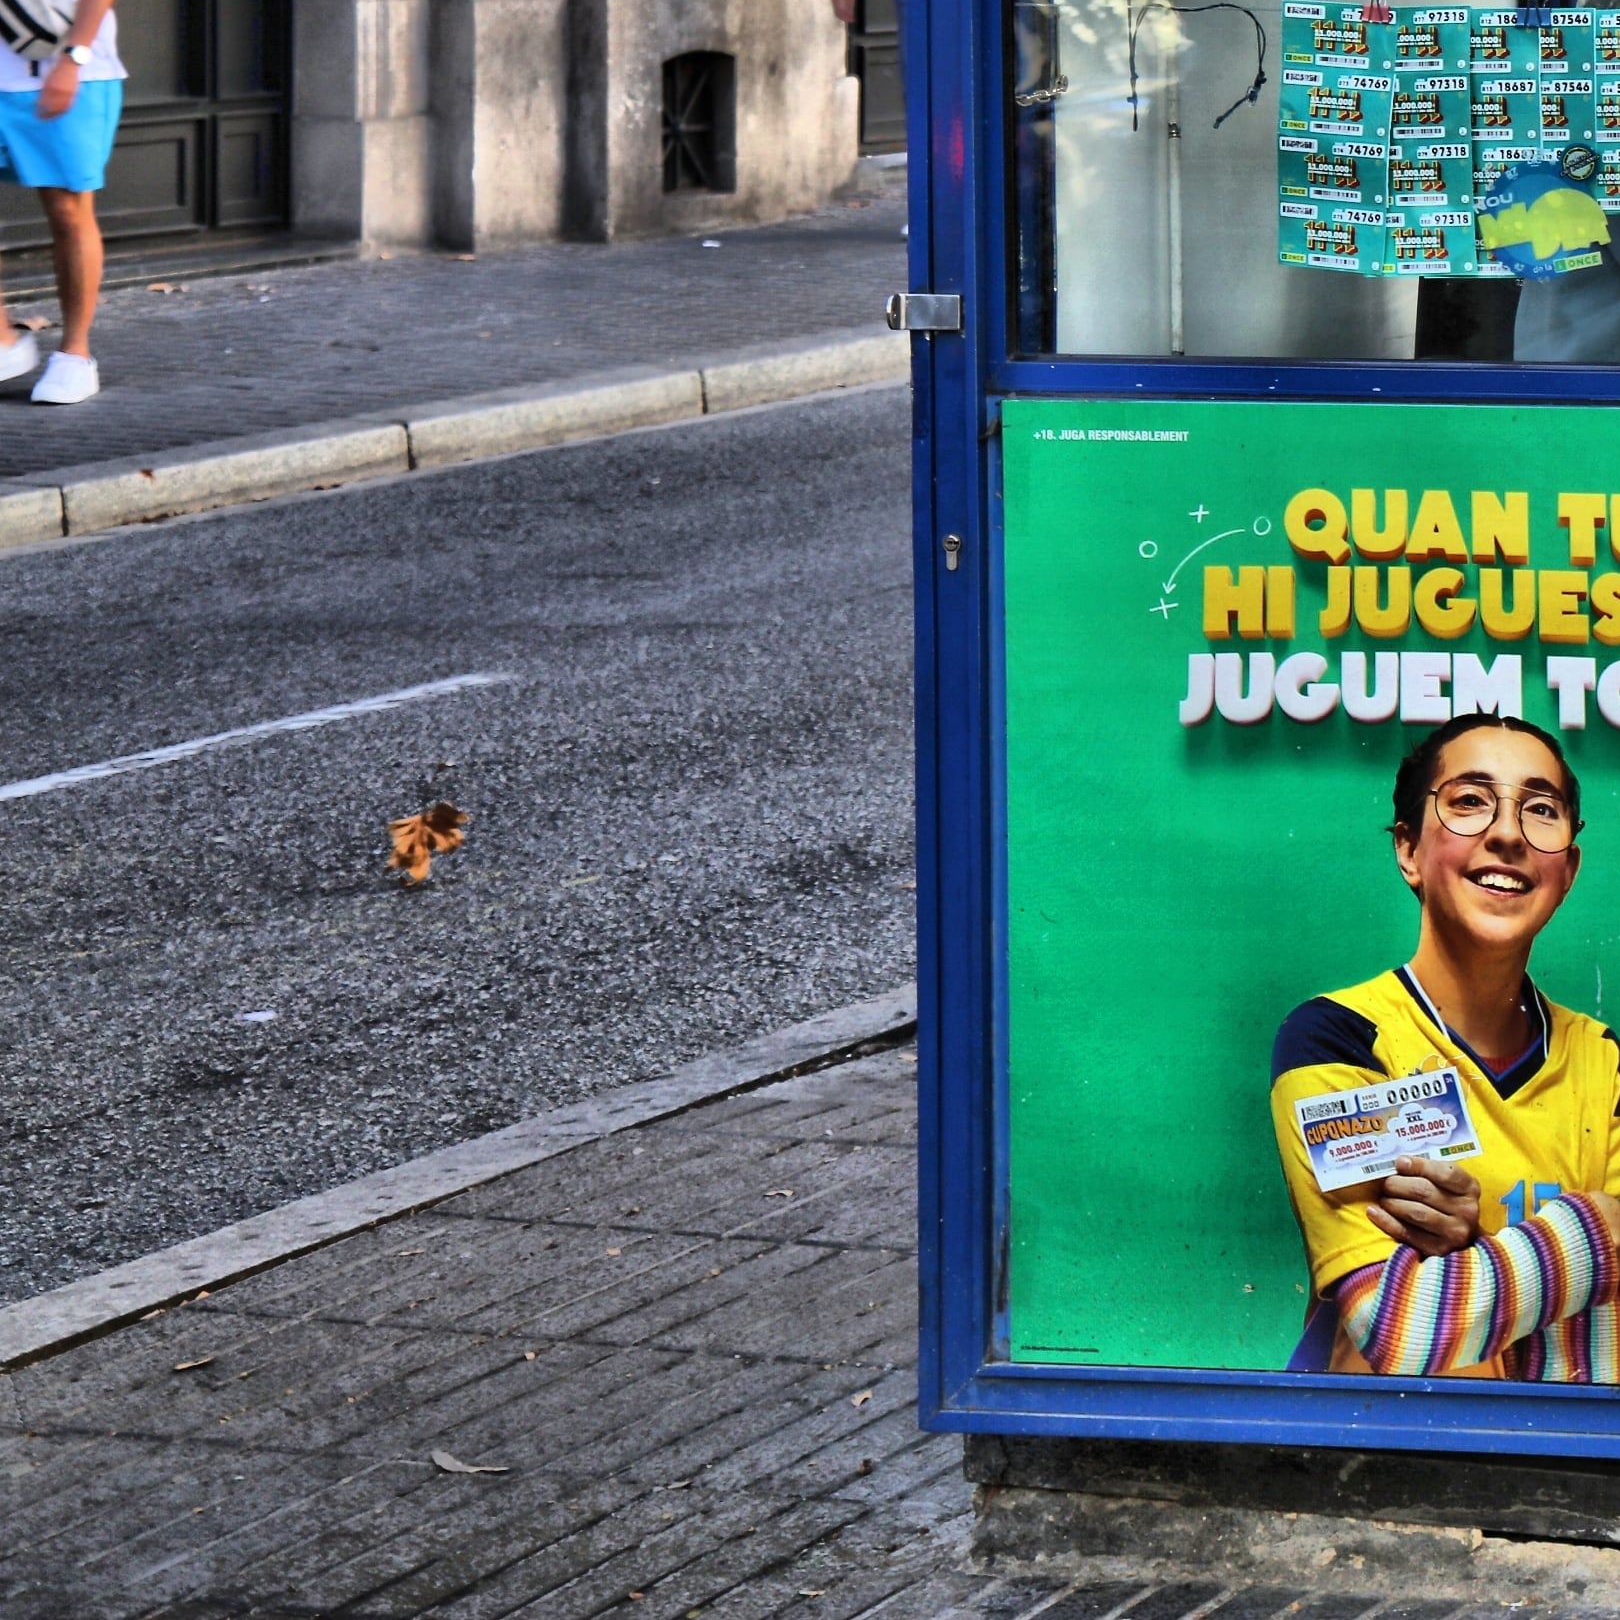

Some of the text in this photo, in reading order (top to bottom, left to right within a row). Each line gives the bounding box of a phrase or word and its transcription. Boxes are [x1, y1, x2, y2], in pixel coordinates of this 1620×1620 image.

[1428, 11, 1465, 23] 97318
[1552, 13, 1589, 26] 87546
[1353, 77, 1389, 90] 74769
[1429, 78, 1465, 90] 97318
[1497, 81, 1534, 93] 18687
[1554, 80, 1590, 92] 87546
[1348, 145, 1383, 157] 74769
[1431, 146, 1466, 158] 97318
[1347, 211, 1382, 224] 74769
[1434, 214, 1470, 225] 97318
[1567, 254, 1600, 268] ONCE
[1058, 430, 1086, 441] JUGA
[1088, 430, 1189, 442] RESPONSABLEMENT
[1283, 487, 1530, 567] QUAN
[1201, 565, 1297, 641] HI
[1179, 649, 1523, 727] JUGUEM
[1387, 1079, 1443, 1105] 00000
[1406, 1114, 1423, 1123] XXL
[1306, 1115, 1385, 1147] CUPONAZO
[1449, 1142, 1476, 1155] ONCE
